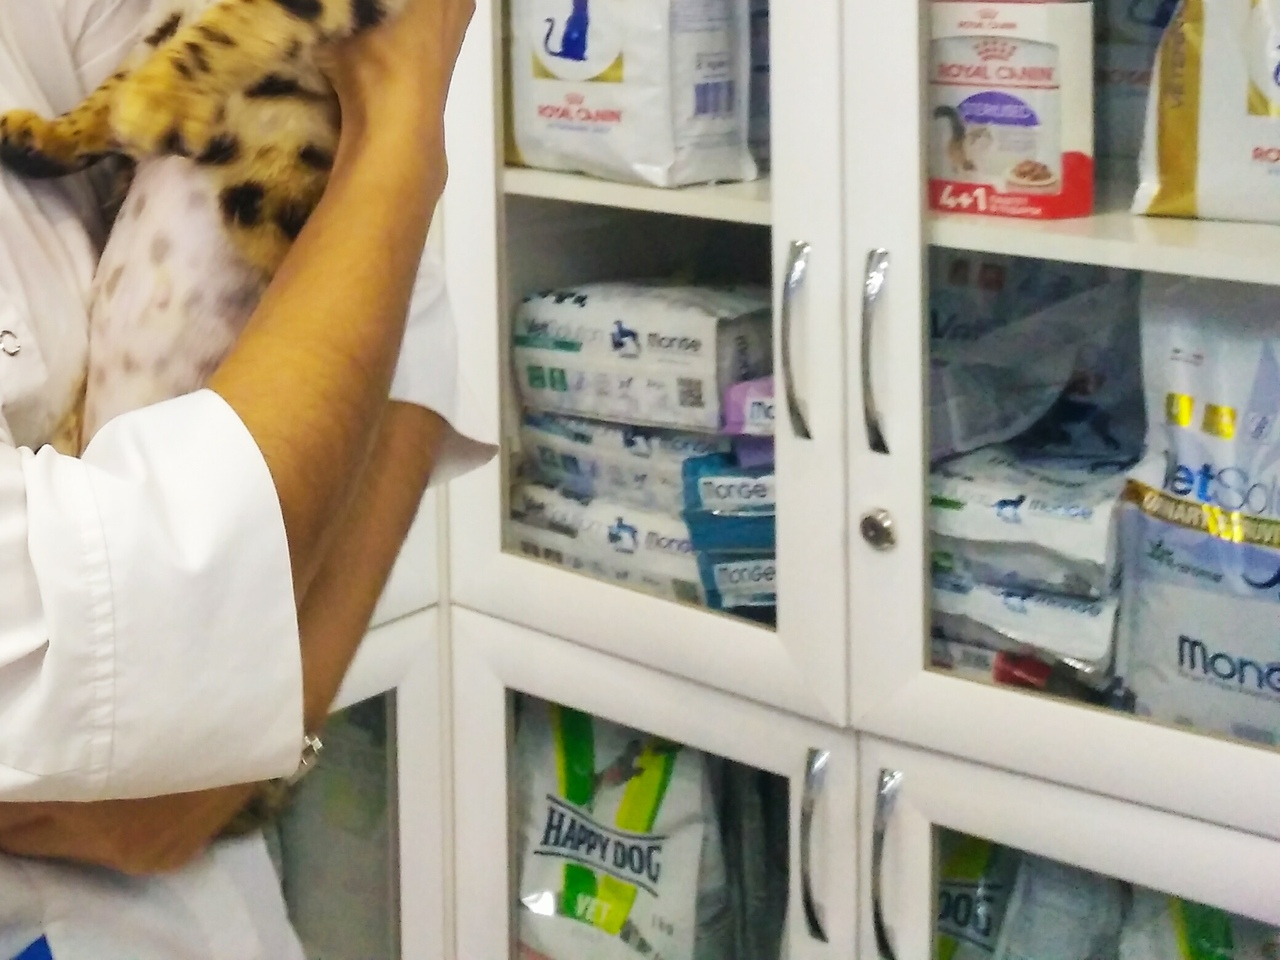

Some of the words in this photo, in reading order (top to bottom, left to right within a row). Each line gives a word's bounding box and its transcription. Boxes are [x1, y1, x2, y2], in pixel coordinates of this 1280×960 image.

[937, 63, 989, 80] ROYAL
[939, 184, 989, 212] 4+1
[540, 805, 610, 863] HAPPY
[612, 839, 662, 884] DOG
